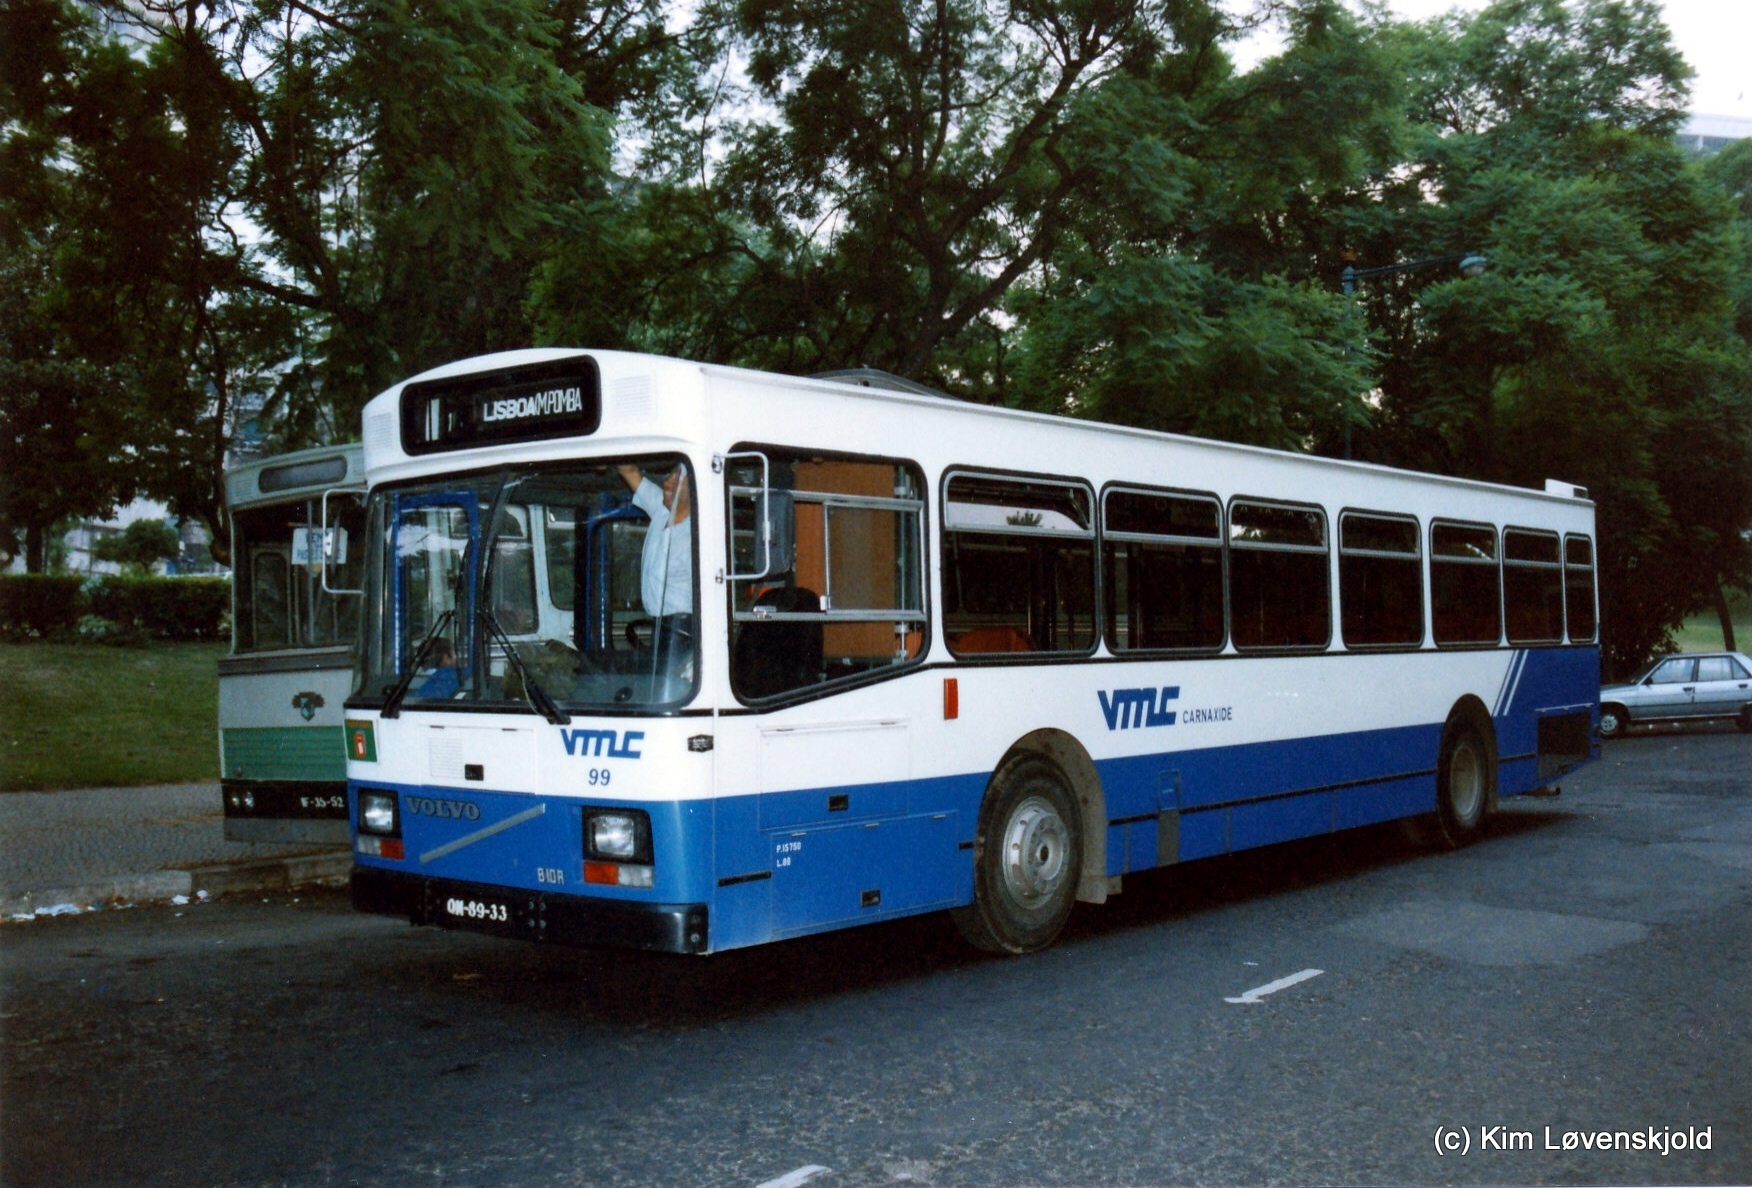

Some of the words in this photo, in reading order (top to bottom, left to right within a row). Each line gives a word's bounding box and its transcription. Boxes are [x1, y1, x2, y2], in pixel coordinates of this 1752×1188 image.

[1182, 707, 1233, 724] CARNAXIDE
[588, 768, 611, 786] 99
[404, 796, 481, 821] VOLVO
[537, 867, 565, 885] B10R
